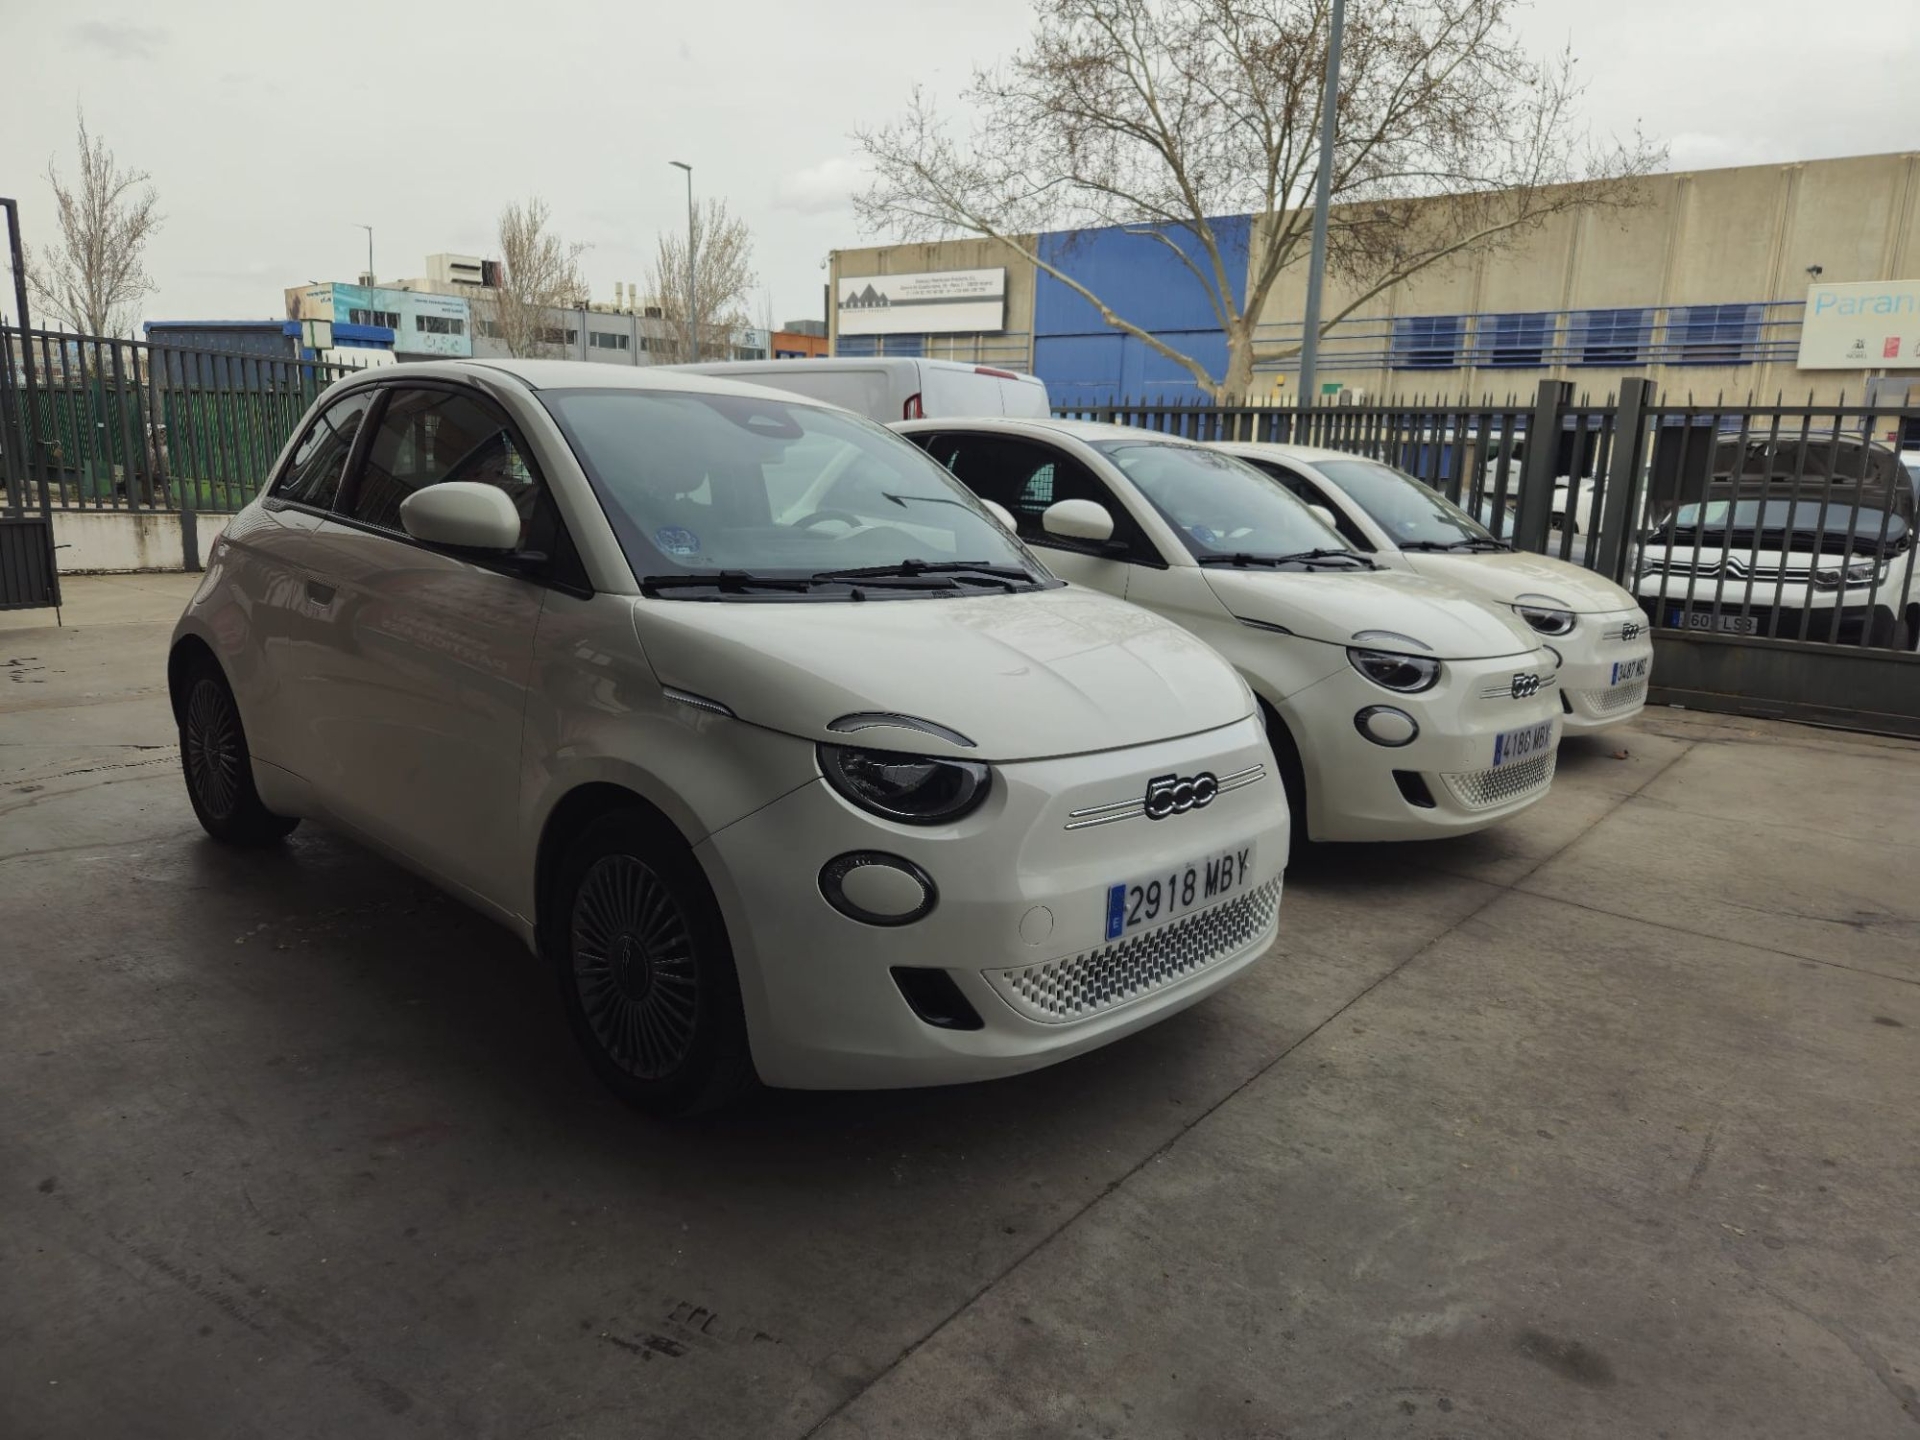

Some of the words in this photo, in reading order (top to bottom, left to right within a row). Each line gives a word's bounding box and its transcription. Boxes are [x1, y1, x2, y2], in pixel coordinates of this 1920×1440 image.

[1815, 291, 1920, 315] Paran
[1512, 673, 1539, 699] 500
[1145, 771, 1218, 820] 500
[1126, 868, 1197, 927] 2918
[1204, 848, 1250, 899] MBY
